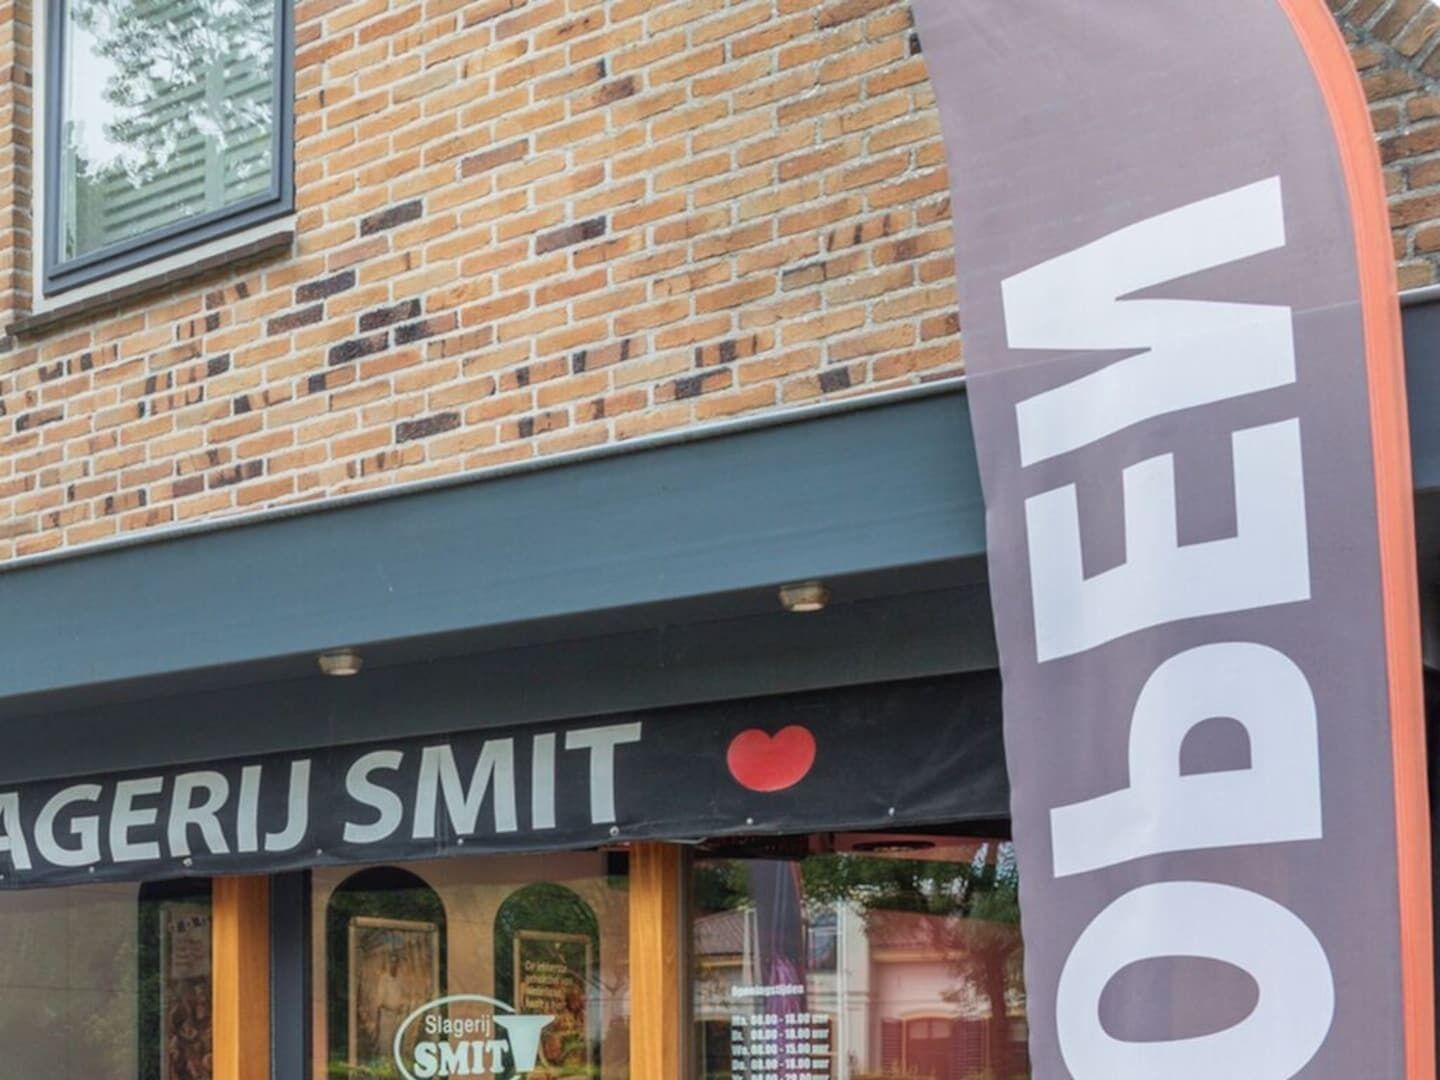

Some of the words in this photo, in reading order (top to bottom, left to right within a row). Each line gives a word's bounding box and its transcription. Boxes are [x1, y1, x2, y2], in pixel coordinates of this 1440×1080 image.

[343, 721, 643, 845] SMIT
[424, 1014, 491, 1037] Slagerij
[414, 1039, 509, 1078] SMIT
